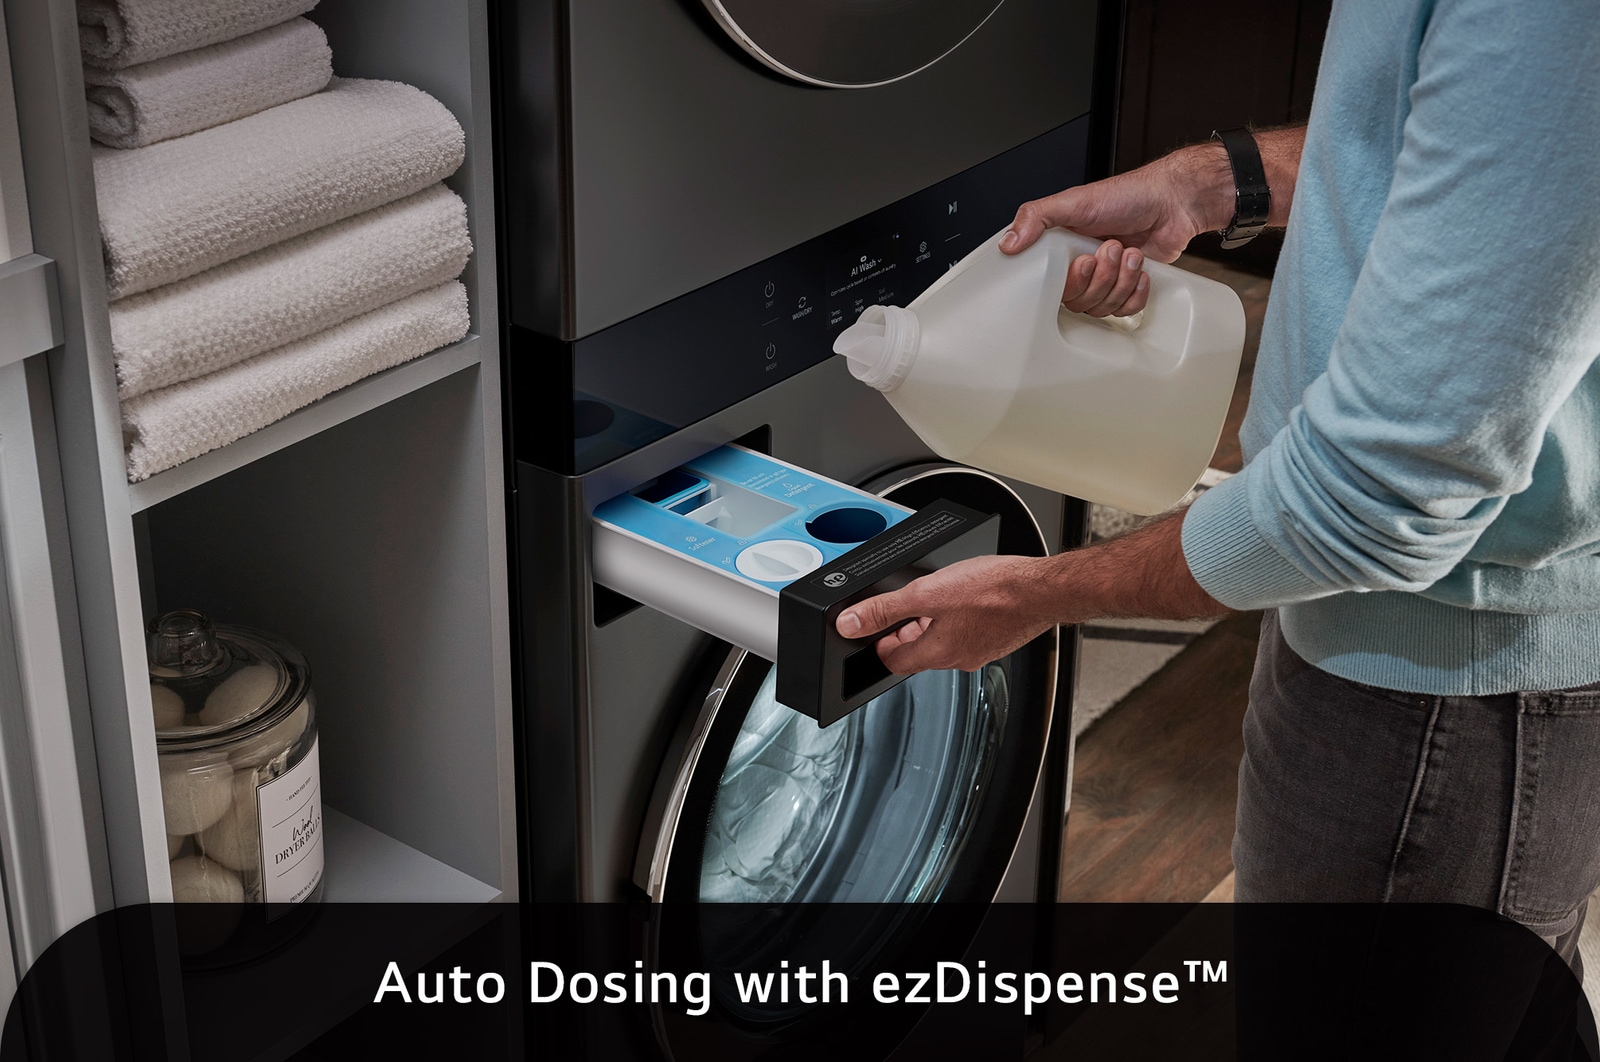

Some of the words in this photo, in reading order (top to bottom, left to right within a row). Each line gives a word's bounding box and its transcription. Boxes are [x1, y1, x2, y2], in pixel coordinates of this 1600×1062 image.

[851, 267, 859, 277] AI
[859, 259, 877, 273] Wash
[688, 537, 716, 551] Softener
[275, 836, 305, 865] DRYER
[305, 813, 321, 843] BALLS
